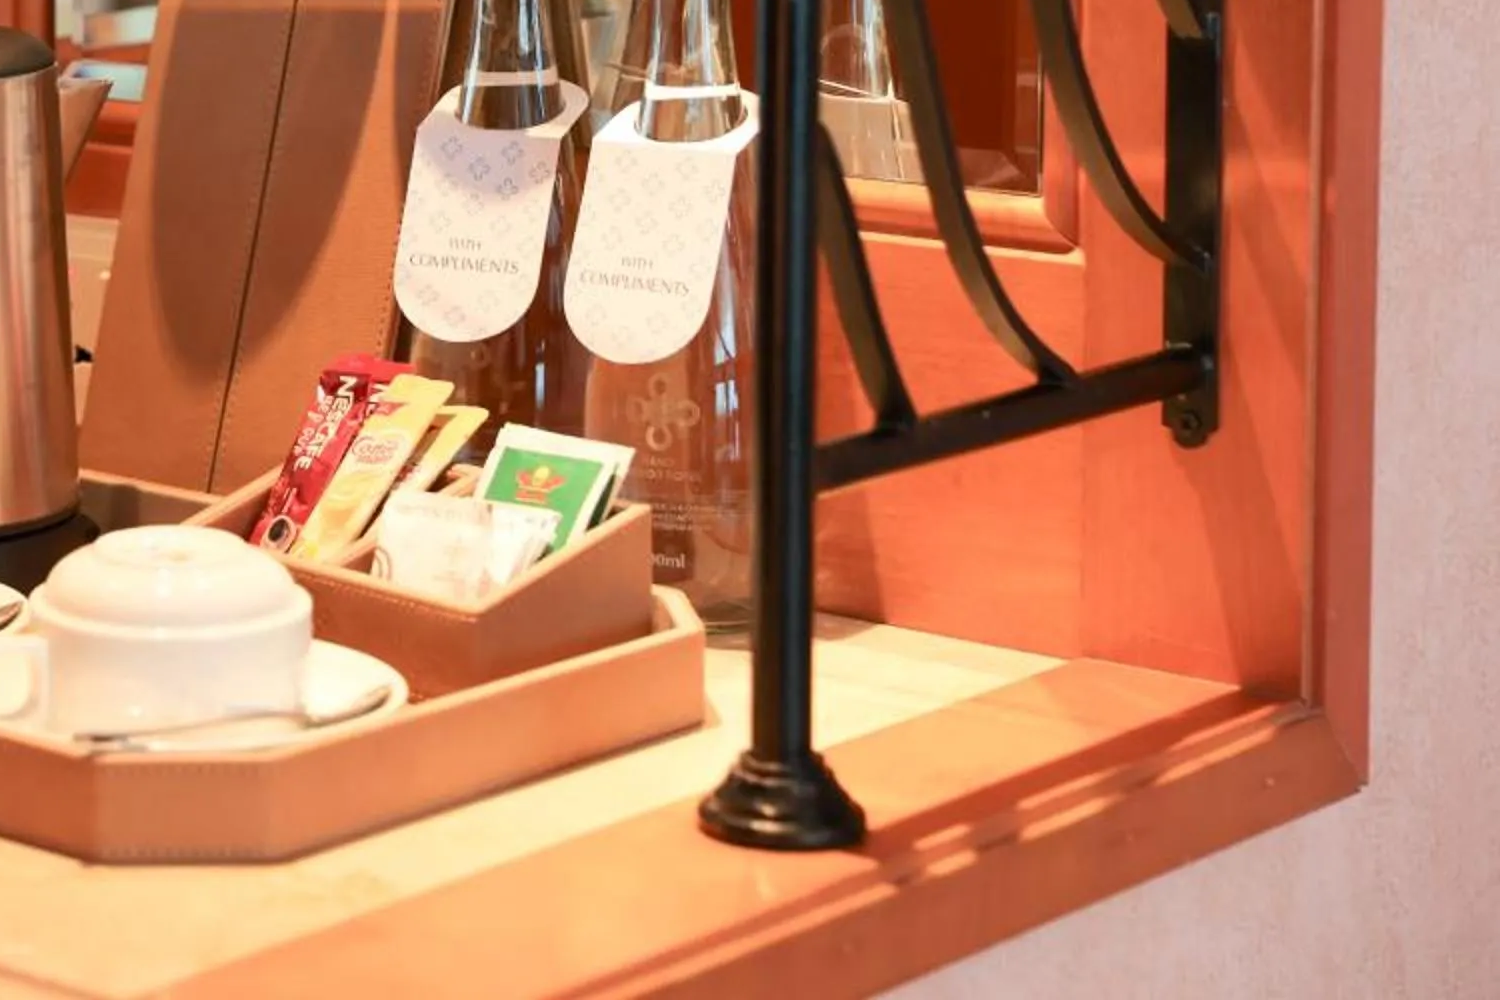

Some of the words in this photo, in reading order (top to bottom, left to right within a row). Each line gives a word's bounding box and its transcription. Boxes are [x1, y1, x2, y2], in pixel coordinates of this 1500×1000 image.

[447, 236, 482, 252] WITH
[408, 253, 520, 275] COMPLIMENTS
[620, 255, 655, 271] WITH
[579, 269, 690, 298] COMPLIMENTS
